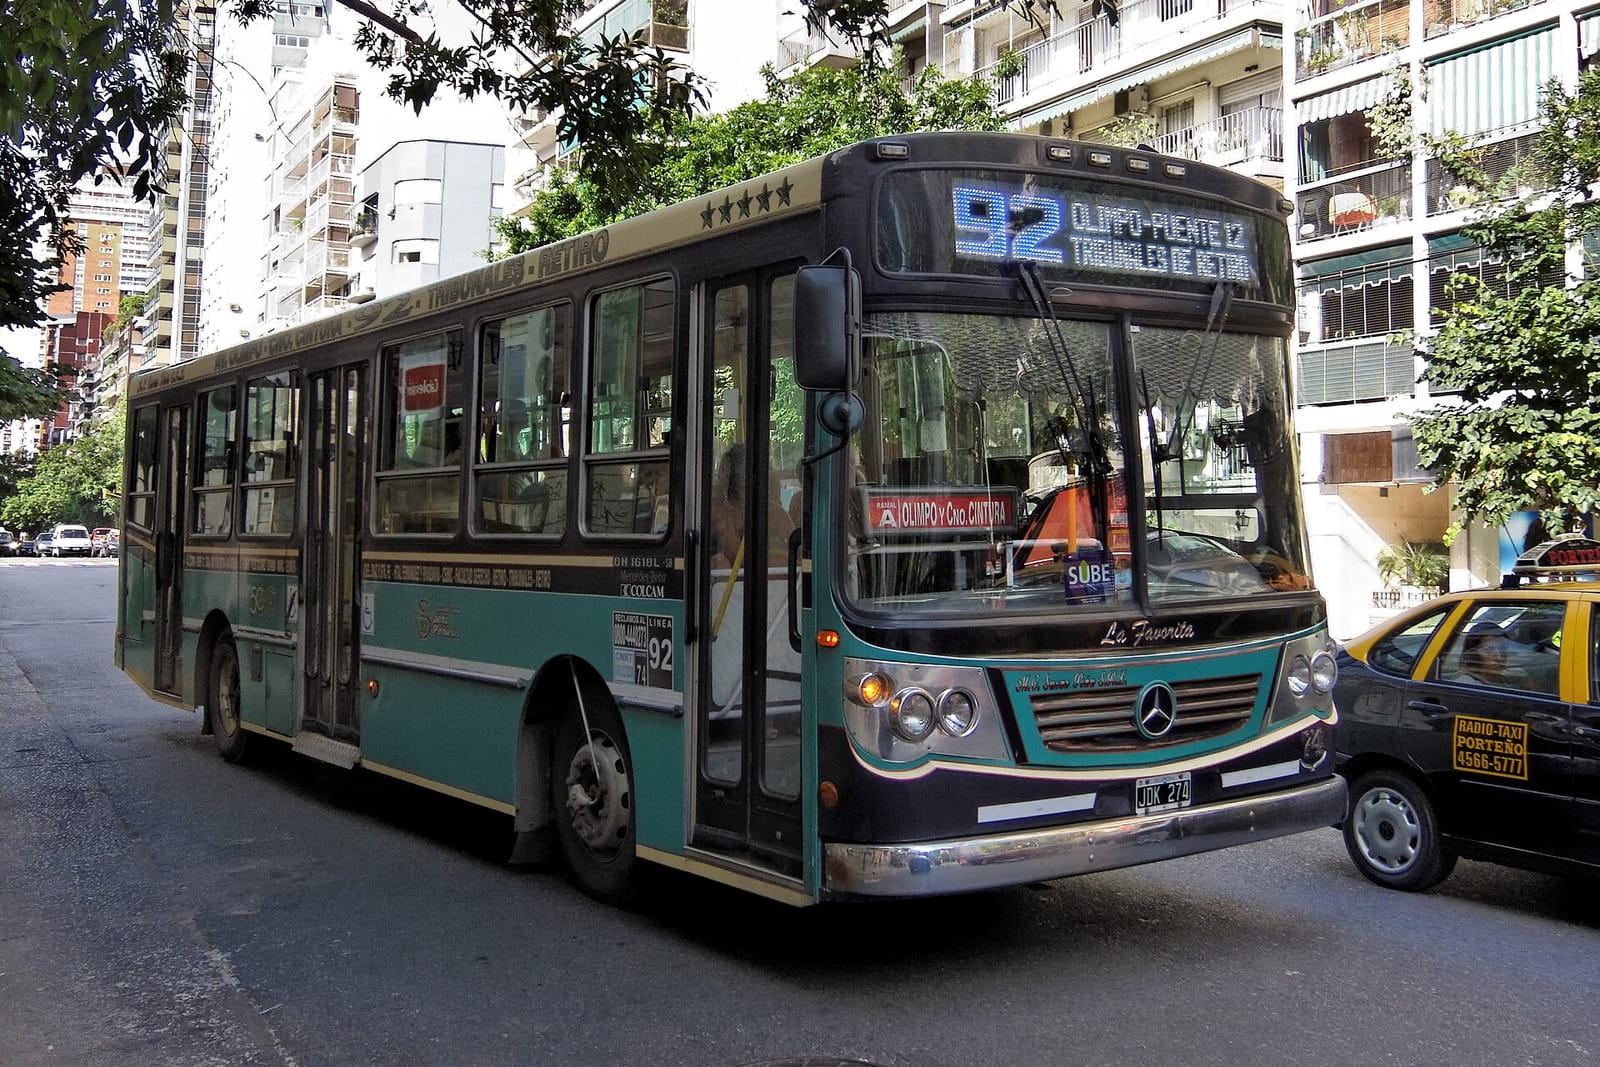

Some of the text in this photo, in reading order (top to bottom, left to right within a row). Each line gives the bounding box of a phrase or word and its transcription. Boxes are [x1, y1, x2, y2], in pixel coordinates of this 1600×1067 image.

[953, 186, 1064, 264] 92
[1224, 220, 1248, 249] 12
[1195, 250, 1250, 282] RETIRO
[353, 293, 414, 331] 92
[428, 256, 526, 310] TRIBUNALES
[538, 229, 610, 278] RETIRO
[879, 509, 897, 528] A
[902, 501, 938, 527] OLIMPO
[968, 501, 1006, 526] CINTURA
[1068, 560, 1111, 586] SUBE
[631, 584, 664, 598] COLCAM
[649, 617, 672, 629] LINEA
[1100, 619, 1195, 647] La Favorita
[649, 636, 673, 672] 92
[1458, 719, 1522, 740] RADIO-TAXI
[1456, 735, 1524, 756] PORTEÑO
[1457, 750, 1522, 775] 4566-5777
[1138, 781, 1189, 807] JDK 274
